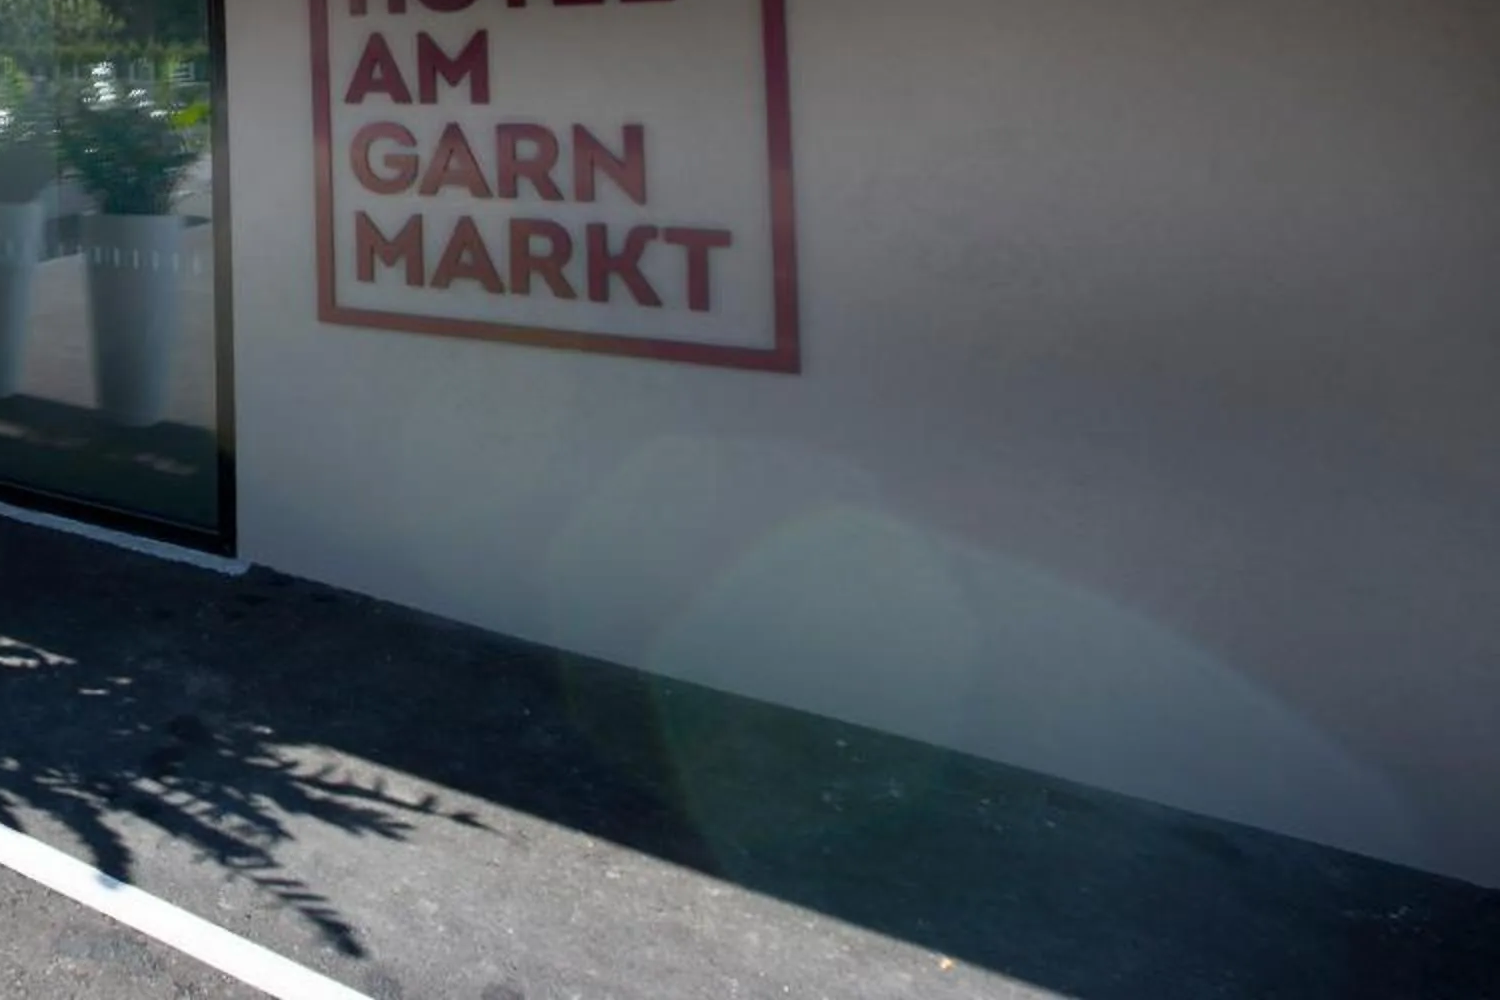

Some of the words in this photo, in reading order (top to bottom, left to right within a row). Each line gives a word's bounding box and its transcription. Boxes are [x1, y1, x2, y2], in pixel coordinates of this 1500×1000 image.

[344, 29, 491, 105] AM
[350, 121, 647, 205] GARN
[355, 210, 732, 312] MARKT
